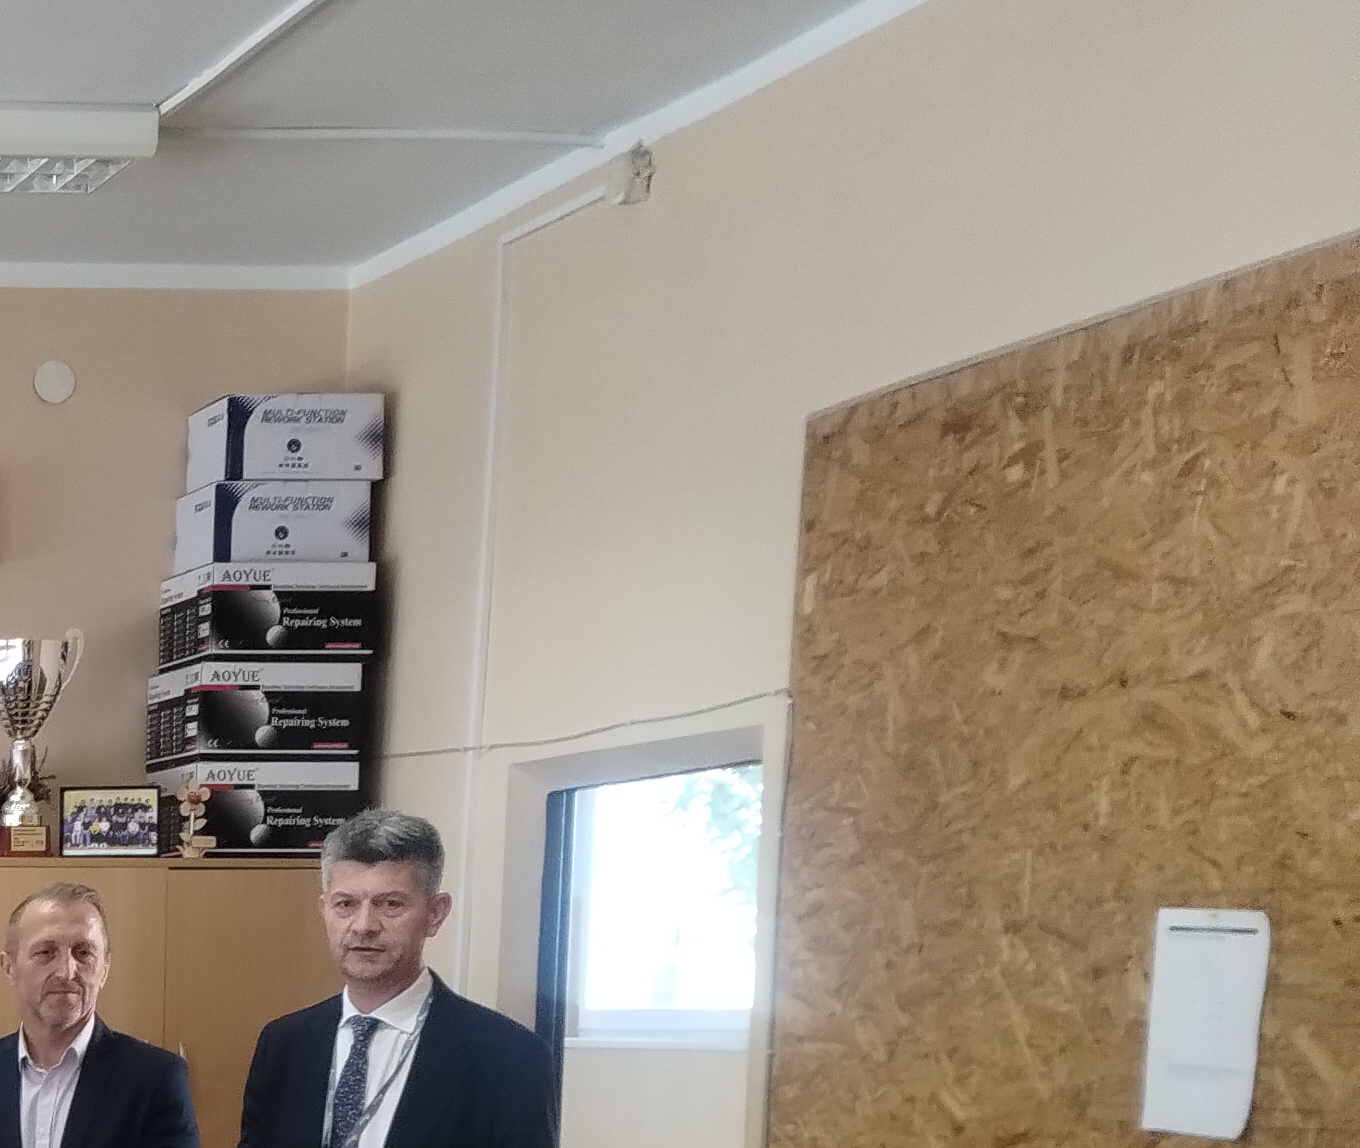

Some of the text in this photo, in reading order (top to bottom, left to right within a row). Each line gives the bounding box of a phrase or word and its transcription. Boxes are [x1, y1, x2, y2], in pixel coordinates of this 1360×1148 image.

[262, 408, 348, 417] MULTI-FUNCTION
[250, 496, 335, 504] MULTI-FUNCTION
[220, 568, 272, 583] AOYUE
[282, 616, 362, 629] Repairing System
[209, 669, 261, 683] AOYUE
[271, 716, 350, 729] Repairing System
[205, 768, 257, 782] AOYUE
[266, 815, 312, 828] Repairing
